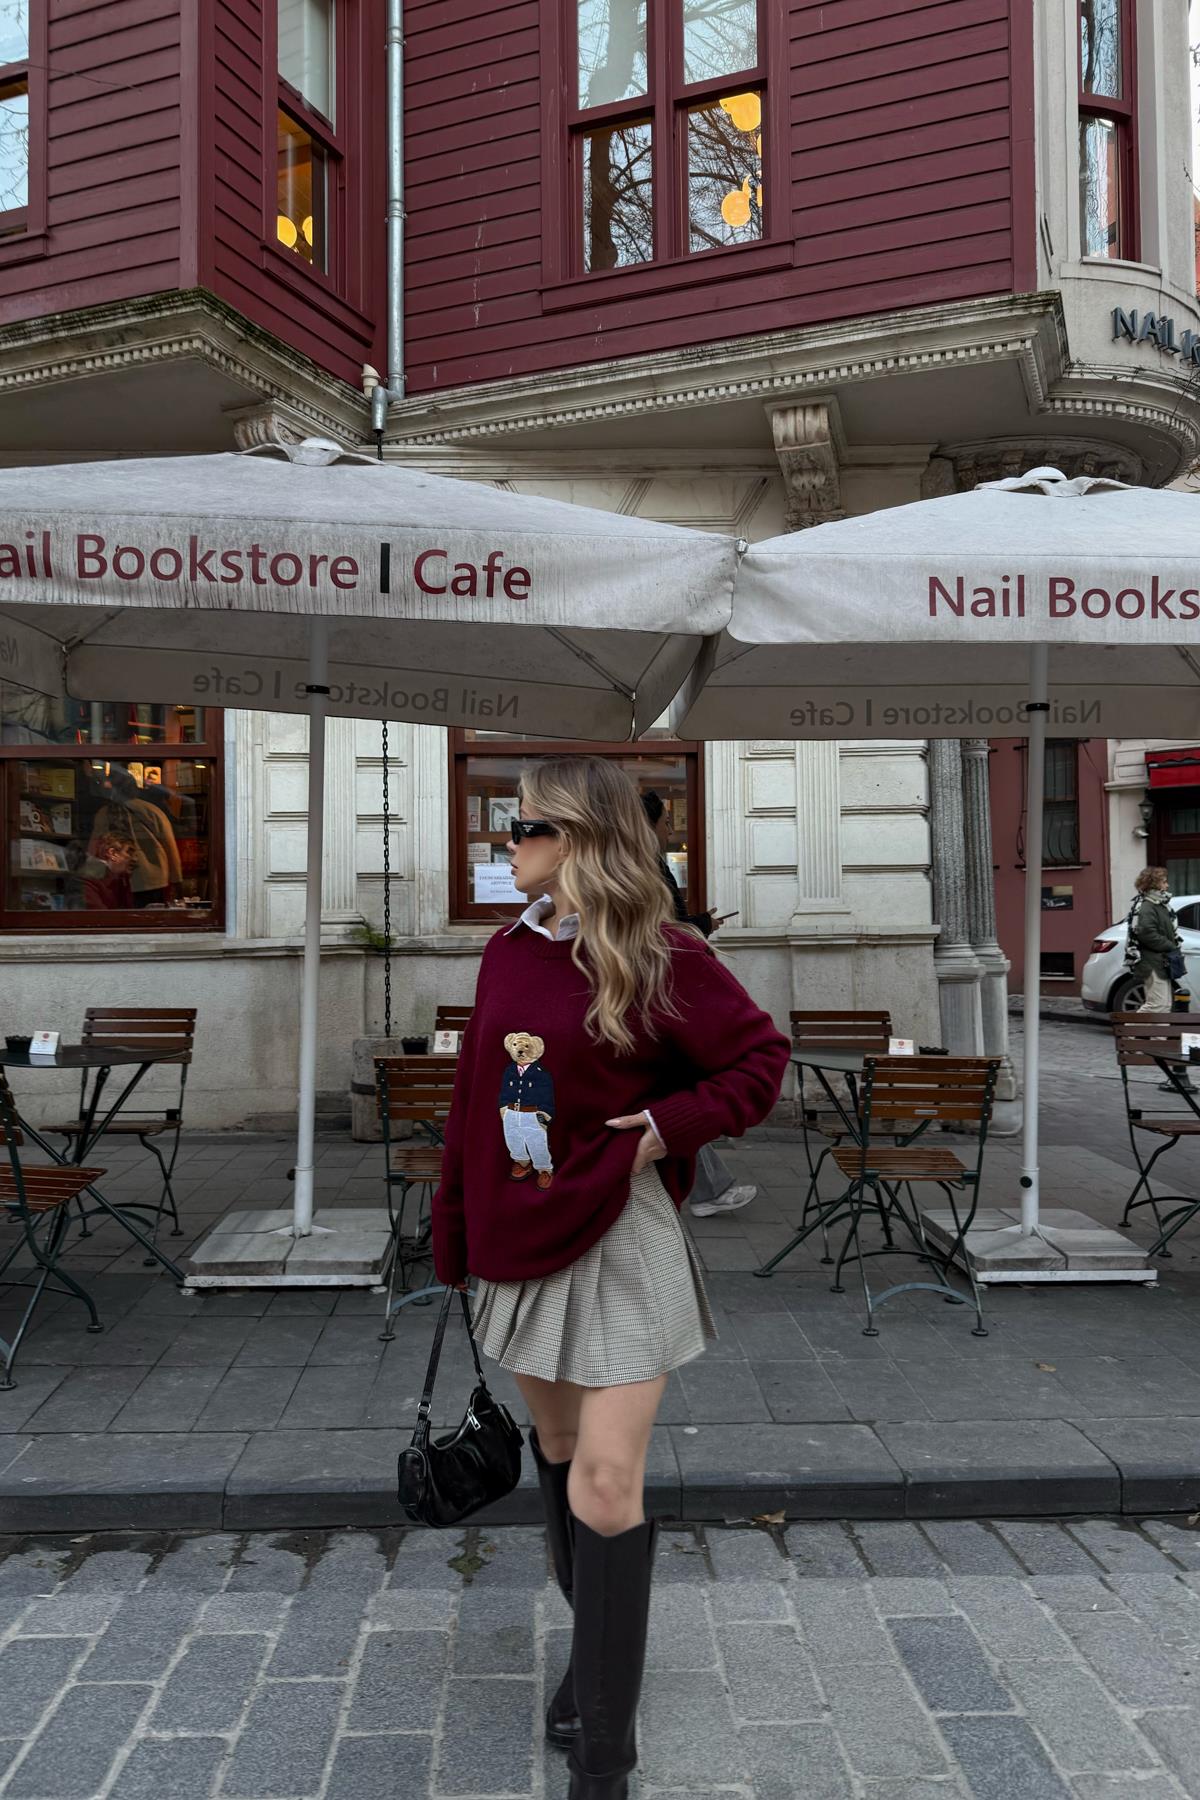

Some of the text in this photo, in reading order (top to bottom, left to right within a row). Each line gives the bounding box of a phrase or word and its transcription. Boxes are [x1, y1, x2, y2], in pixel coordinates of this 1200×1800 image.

[76, 534, 360, 589] Bookstore
[413, 549, 532, 600] Cafe
[928, 574, 1200, 620] Nail Books
